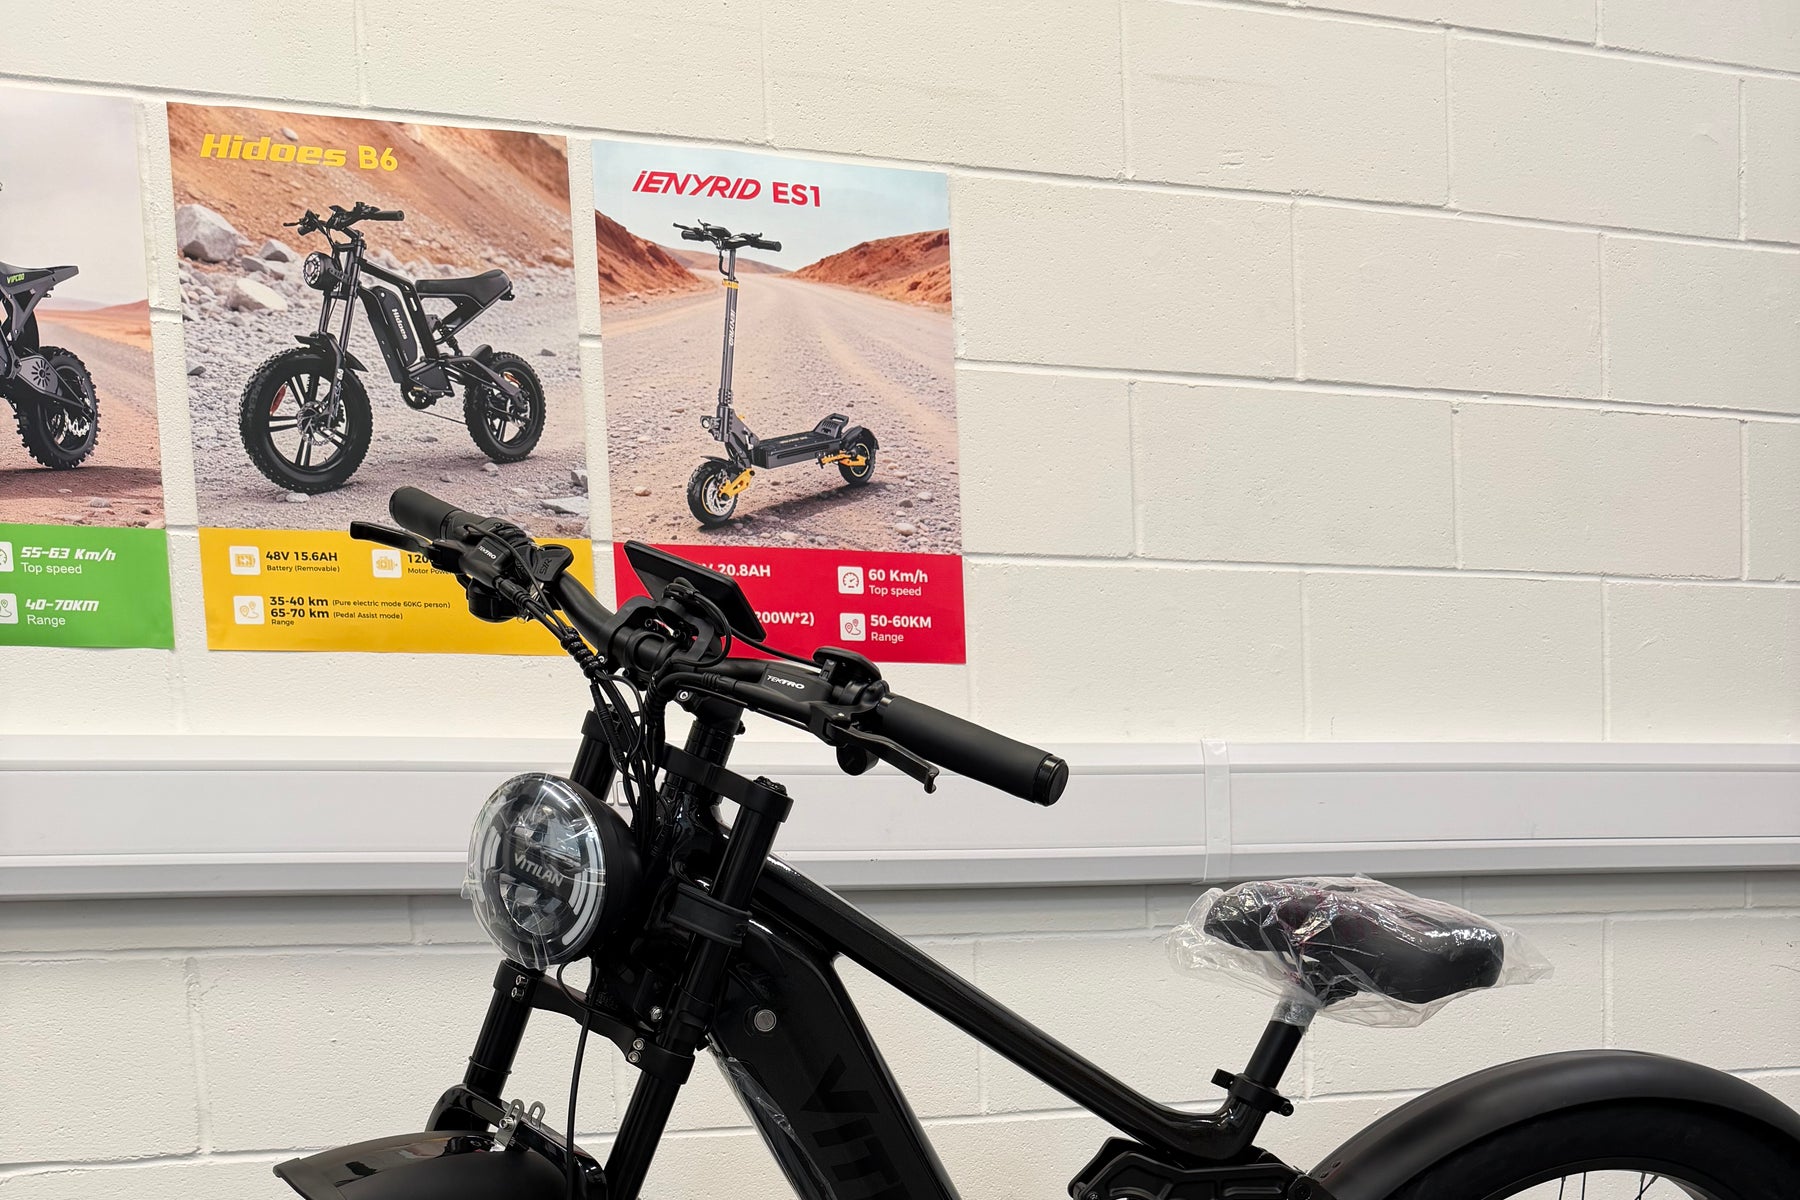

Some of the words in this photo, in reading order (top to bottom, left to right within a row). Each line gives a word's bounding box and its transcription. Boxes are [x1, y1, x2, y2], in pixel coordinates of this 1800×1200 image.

[200, 133, 347, 167] Hidoes
[358, 145, 398, 171] B6
[772, 181, 820, 207] ES1
[392, 308, 408, 340] Hidoes
[20, 546, 70, 559] 55-63
[74, 547, 116, 562] Km/h
[265, 551, 290, 562] 48V
[294, 551, 338, 562] 15.6AH
[407, 553, 429, 564] 120
[21, 562, 43, 575] Top
[46, 564, 82, 575] speed
[266, 564, 293, 573] Battery
[294, 565, 340, 573] (Removable)
[717, 563, 771, 577] 20.8AH
[868, 569, 886, 581] 60
[890, 570, 928, 583] Km/h
[868, 585, 888, 596] Top
[890, 586, 922, 597] speed
[25, 598, 99, 612] 40-70KM
[269, 596, 305, 606] 35-40
[308, 596, 329, 606] km
[424, 601, 451, 609] person)
[270, 608, 306, 618] 65-70
[309, 608, 330, 618] km
[333, 611, 356, 619] (Pedal
[379, 612, 403, 620] mode)
[27, 615, 66, 627] Range
[271, 619, 295, 627] Range
[870, 614, 932, 629] 50-60KM
[871, 632, 904, 643] Range
[514, 852, 565, 888] VITILAN
